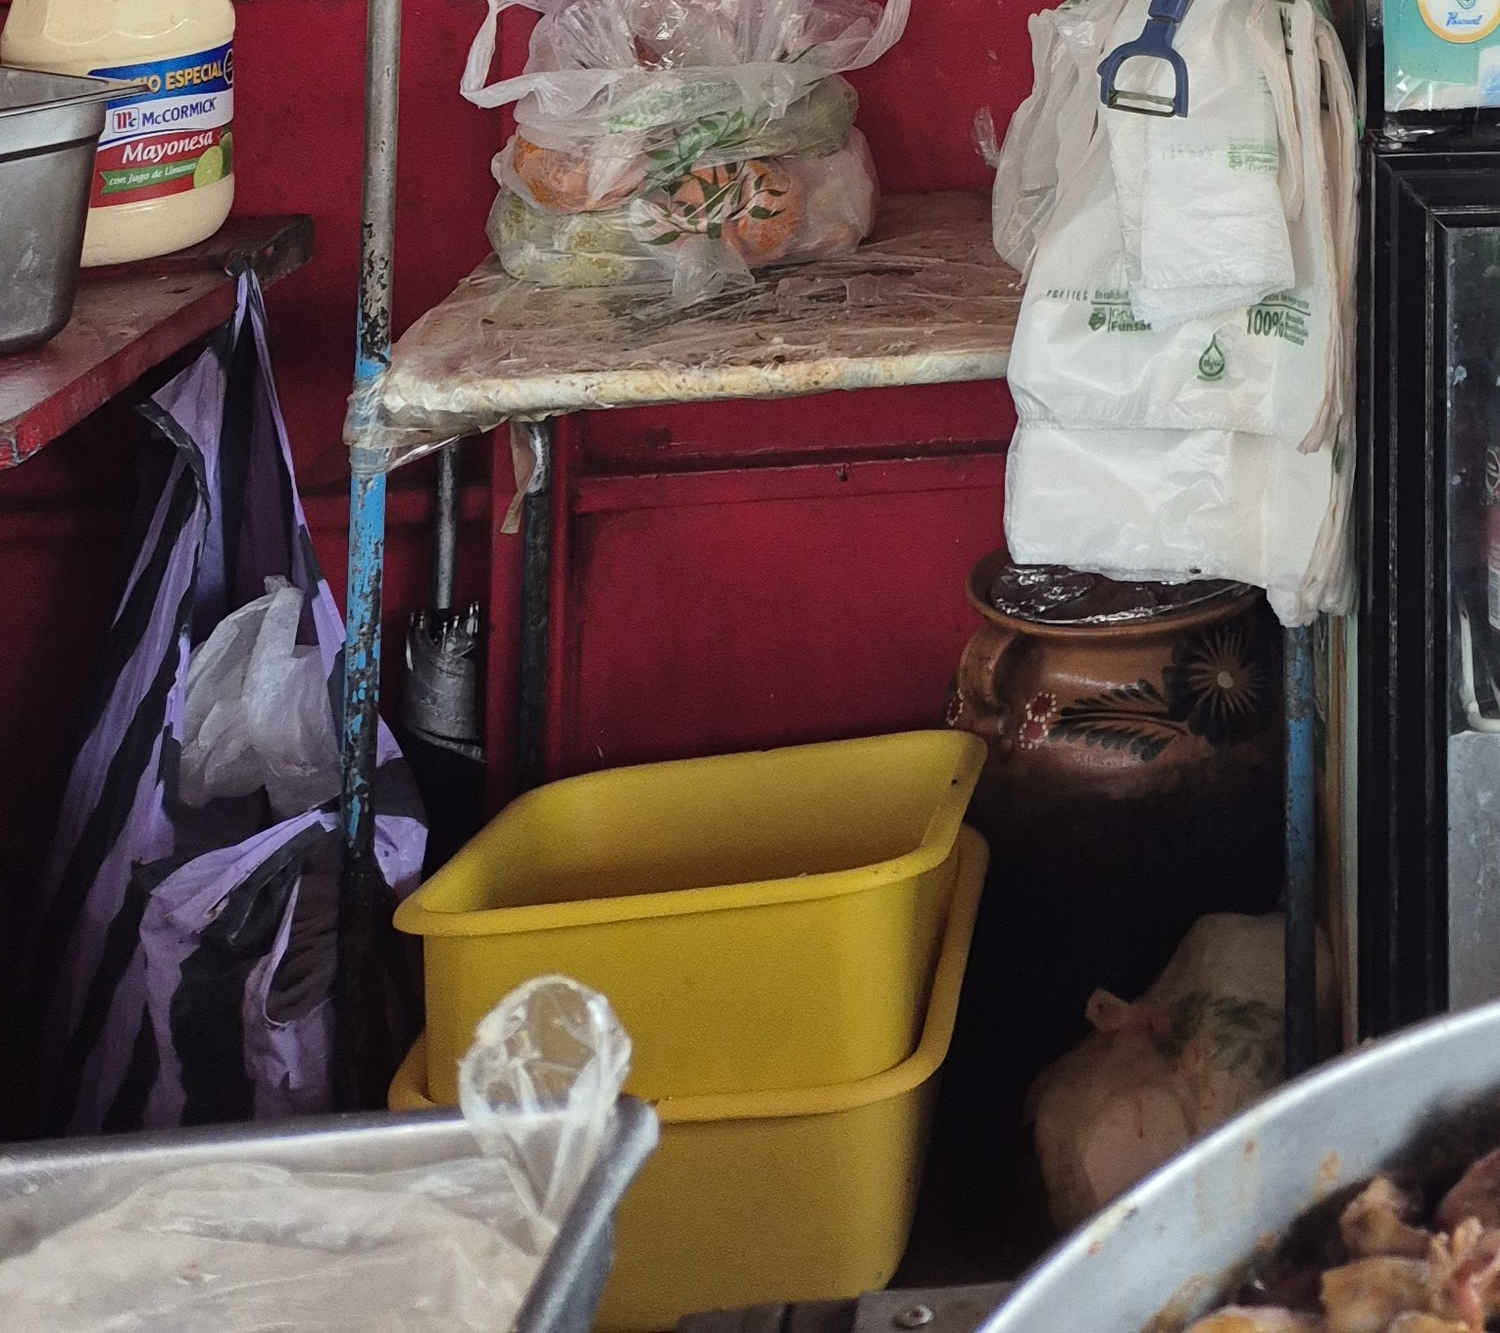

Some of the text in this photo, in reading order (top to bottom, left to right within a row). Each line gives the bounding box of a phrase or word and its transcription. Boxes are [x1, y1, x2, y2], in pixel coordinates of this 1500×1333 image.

[166, 61, 222, 90] ESPECIAL
[142, 97, 218, 126] McCORMICK
[122, 131, 213, 164] Mayonesa
[109, 177, 126, 185] con
[151, 169, 163, 178] de
[165, 162, 196, 177] Limones
[1246, 308, 1285, 338] 100%
